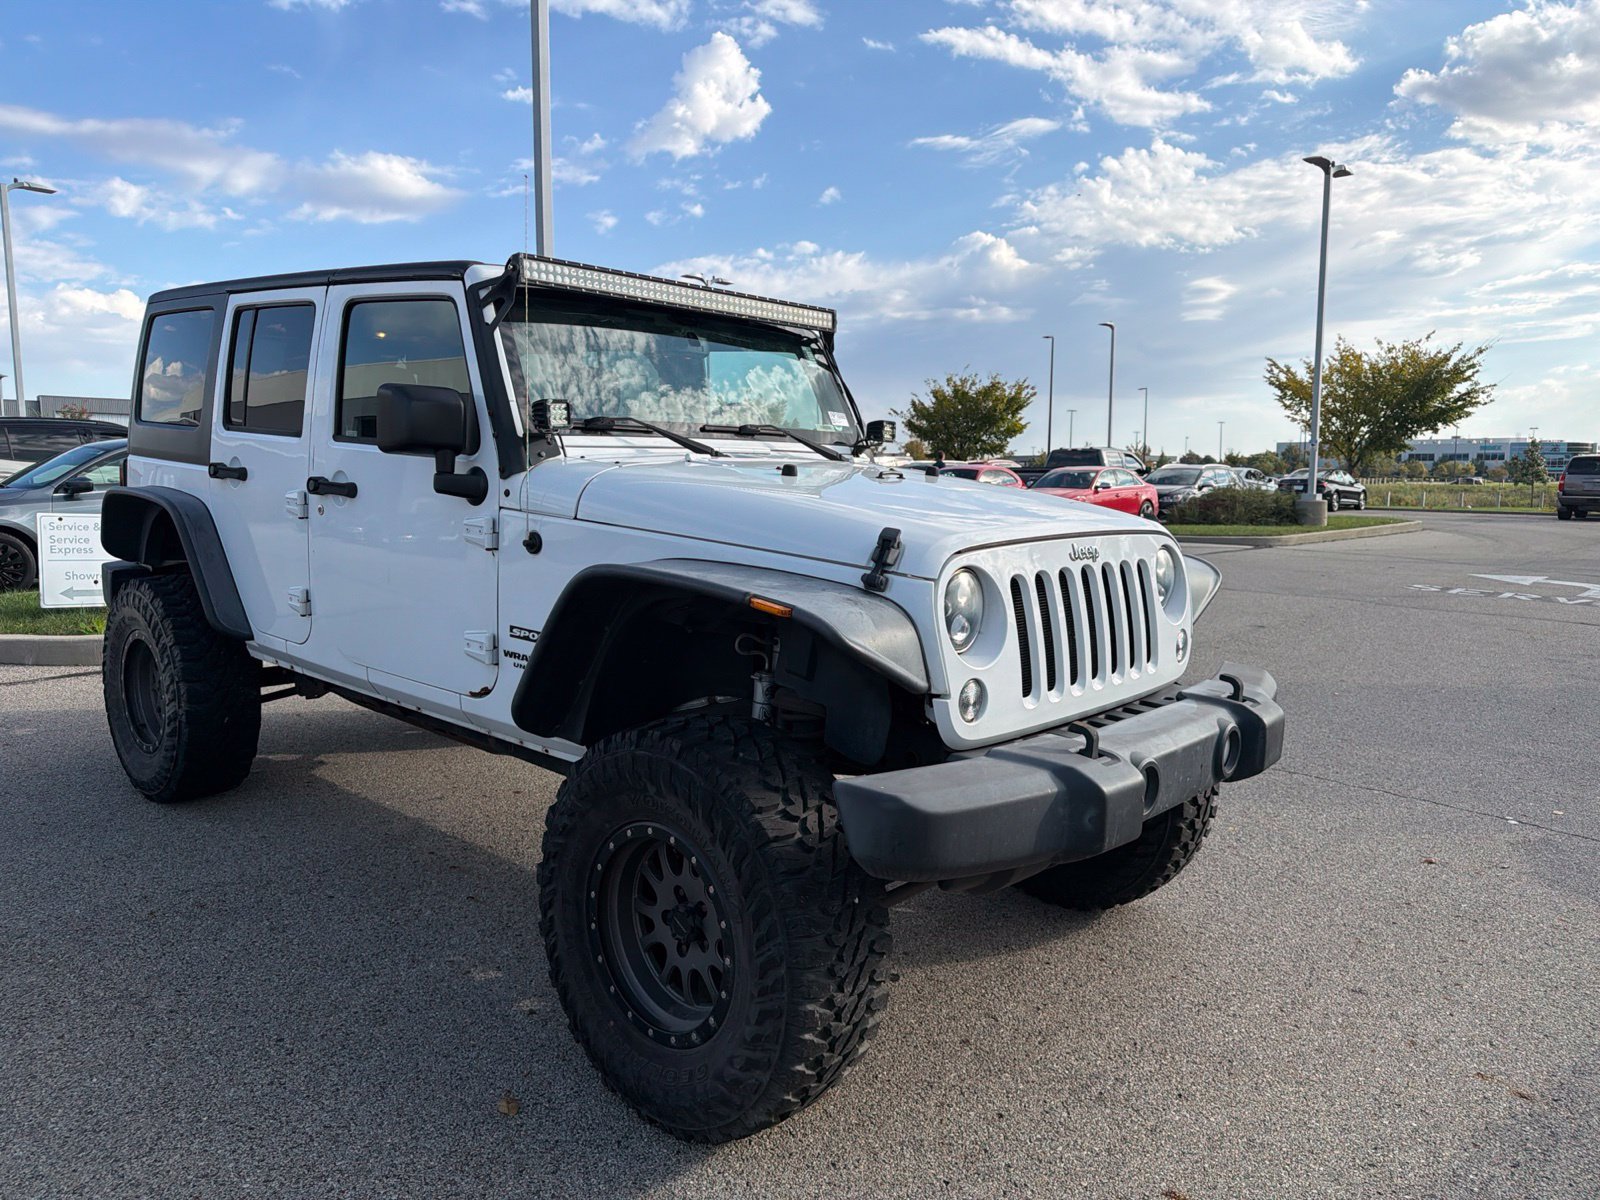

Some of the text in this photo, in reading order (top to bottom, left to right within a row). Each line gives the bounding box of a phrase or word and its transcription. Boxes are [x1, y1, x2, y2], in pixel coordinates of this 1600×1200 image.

[48, 522, 101, 531] Service &
[49, 535, 90, 544] Service
[49, 545, 94, 556] Express
[1068, 543, 1099, 562] Jeep
[64, 571, 102, 580] Showr
[511, 627, 540, 640] SPO
[503, 650, 531, 662] WRA
[513, 661, 527, 670] UN
